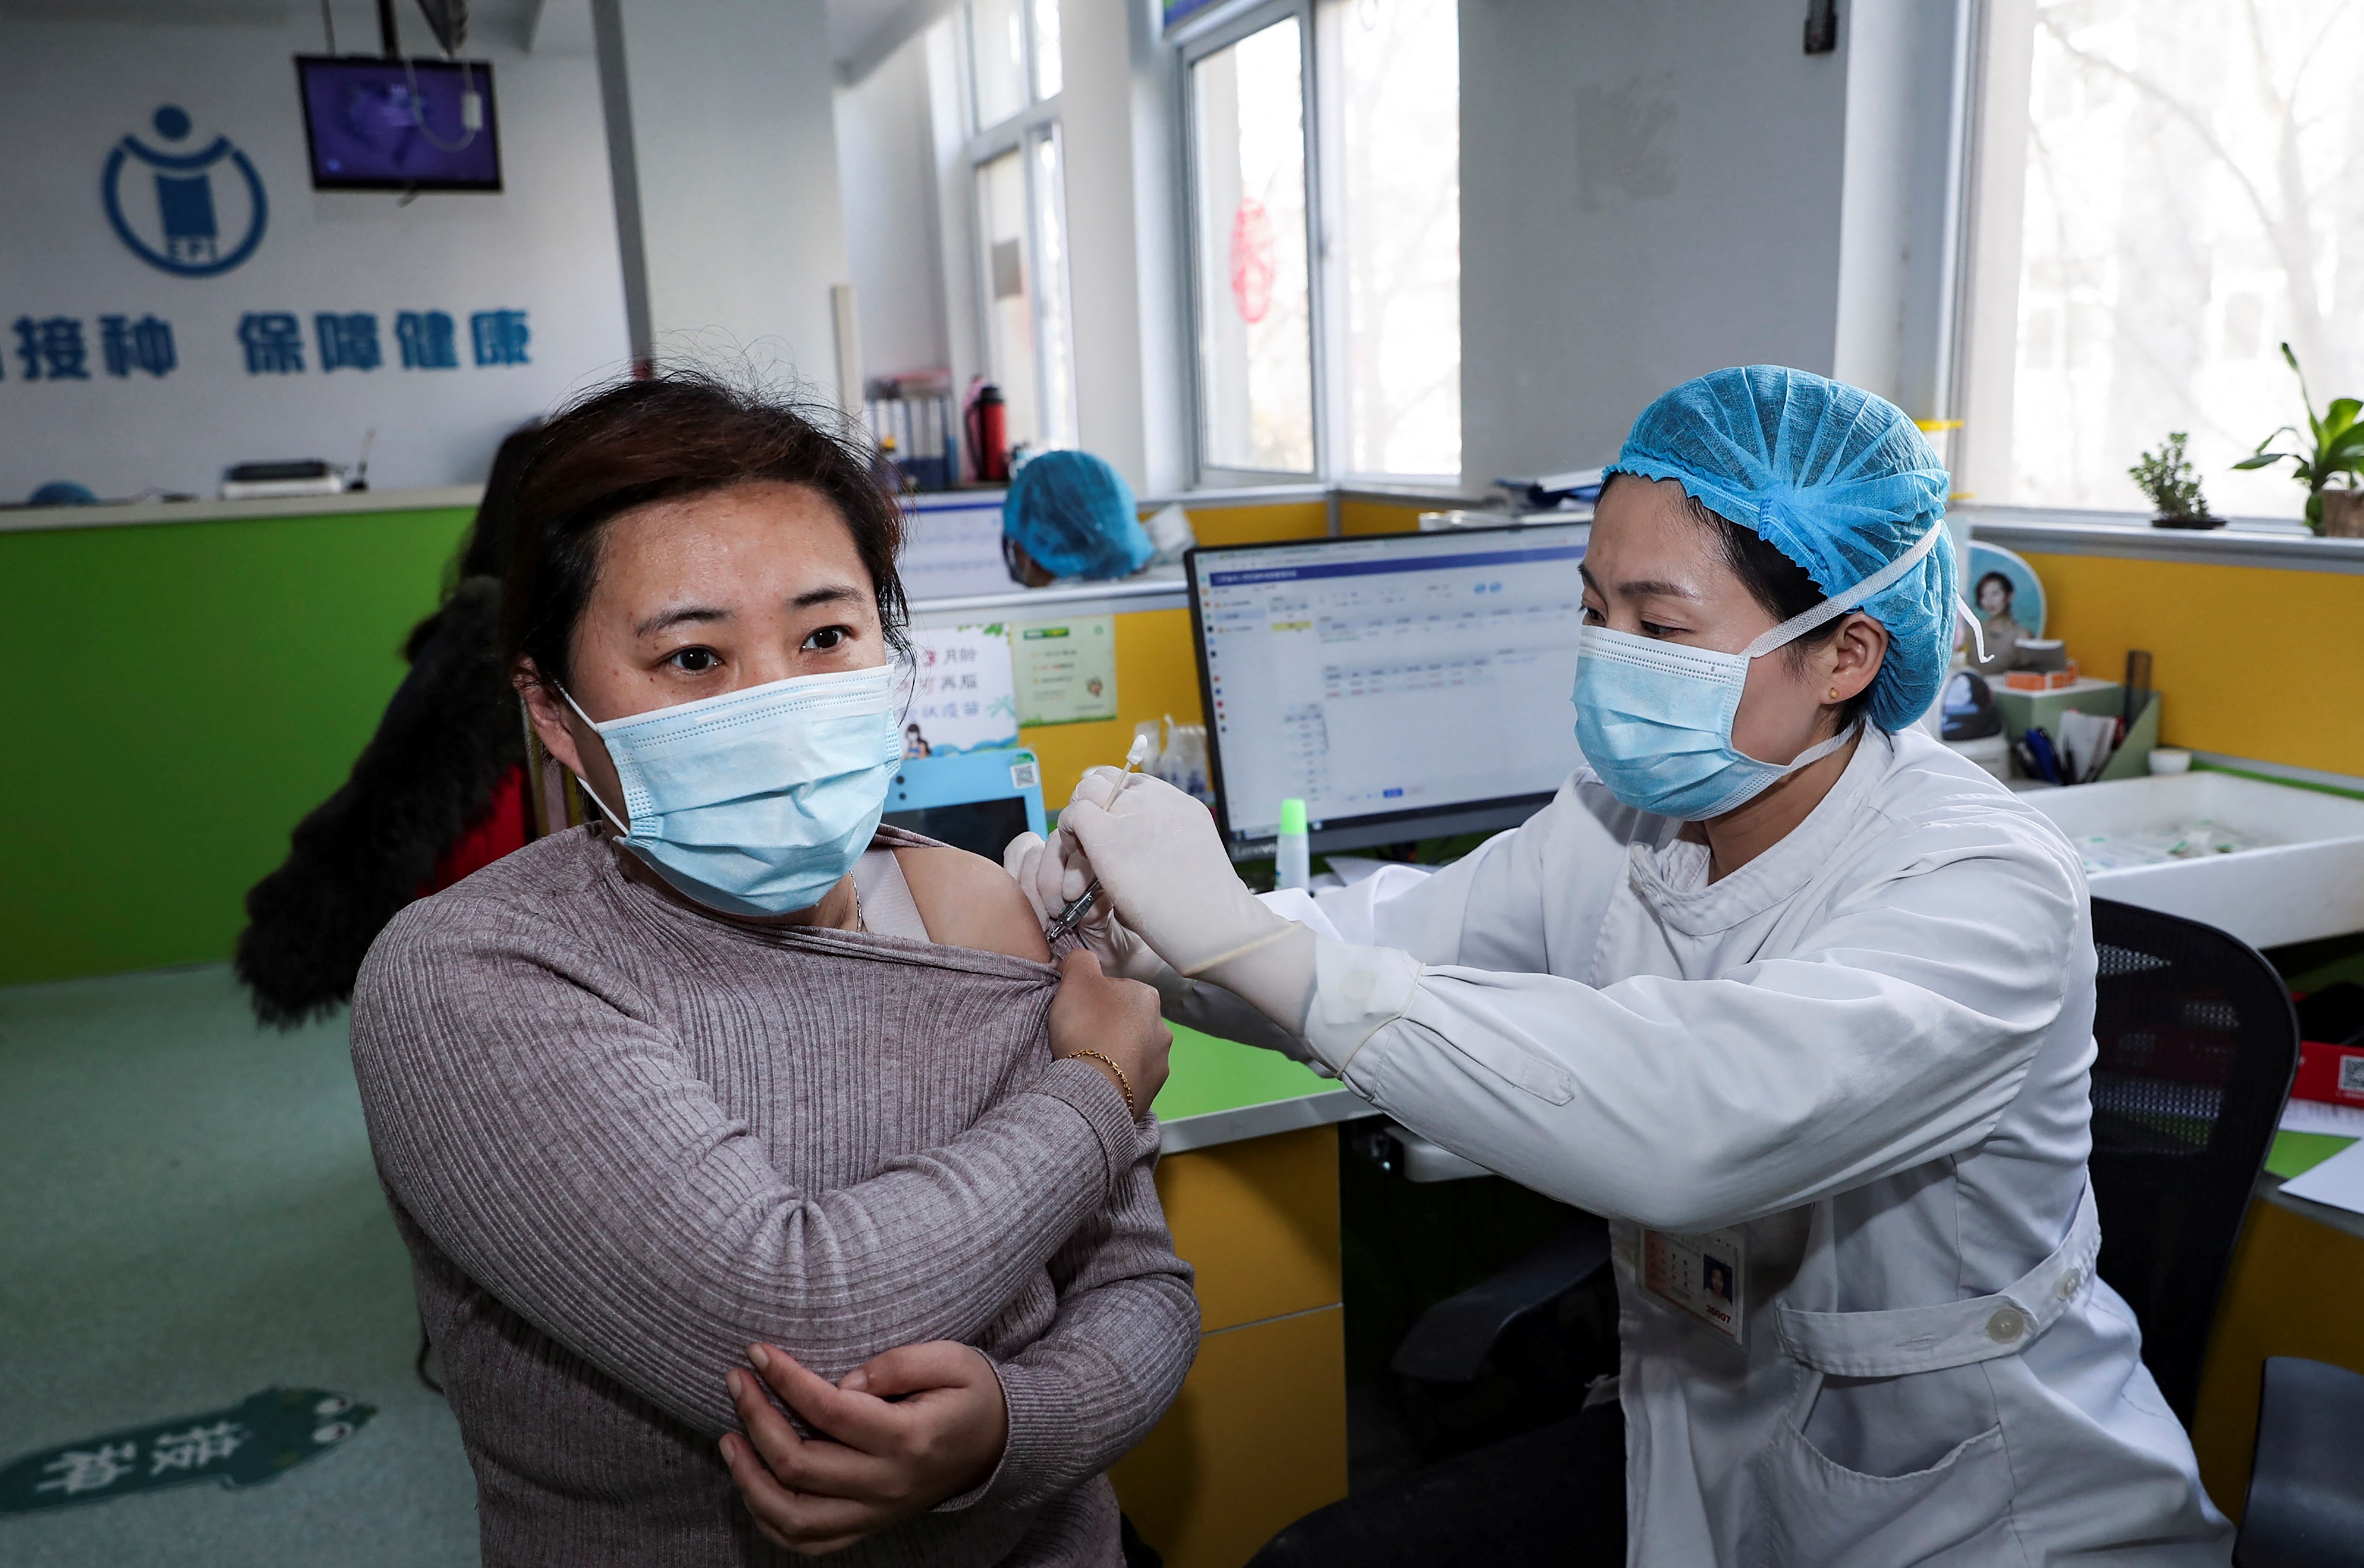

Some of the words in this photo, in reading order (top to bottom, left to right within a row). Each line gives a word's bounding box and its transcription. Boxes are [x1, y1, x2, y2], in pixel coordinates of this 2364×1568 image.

[167, 240, 218, 262] EPI
[0, 314, 178, 379] 接种
[237, 307, 533, 374] 保障健康
